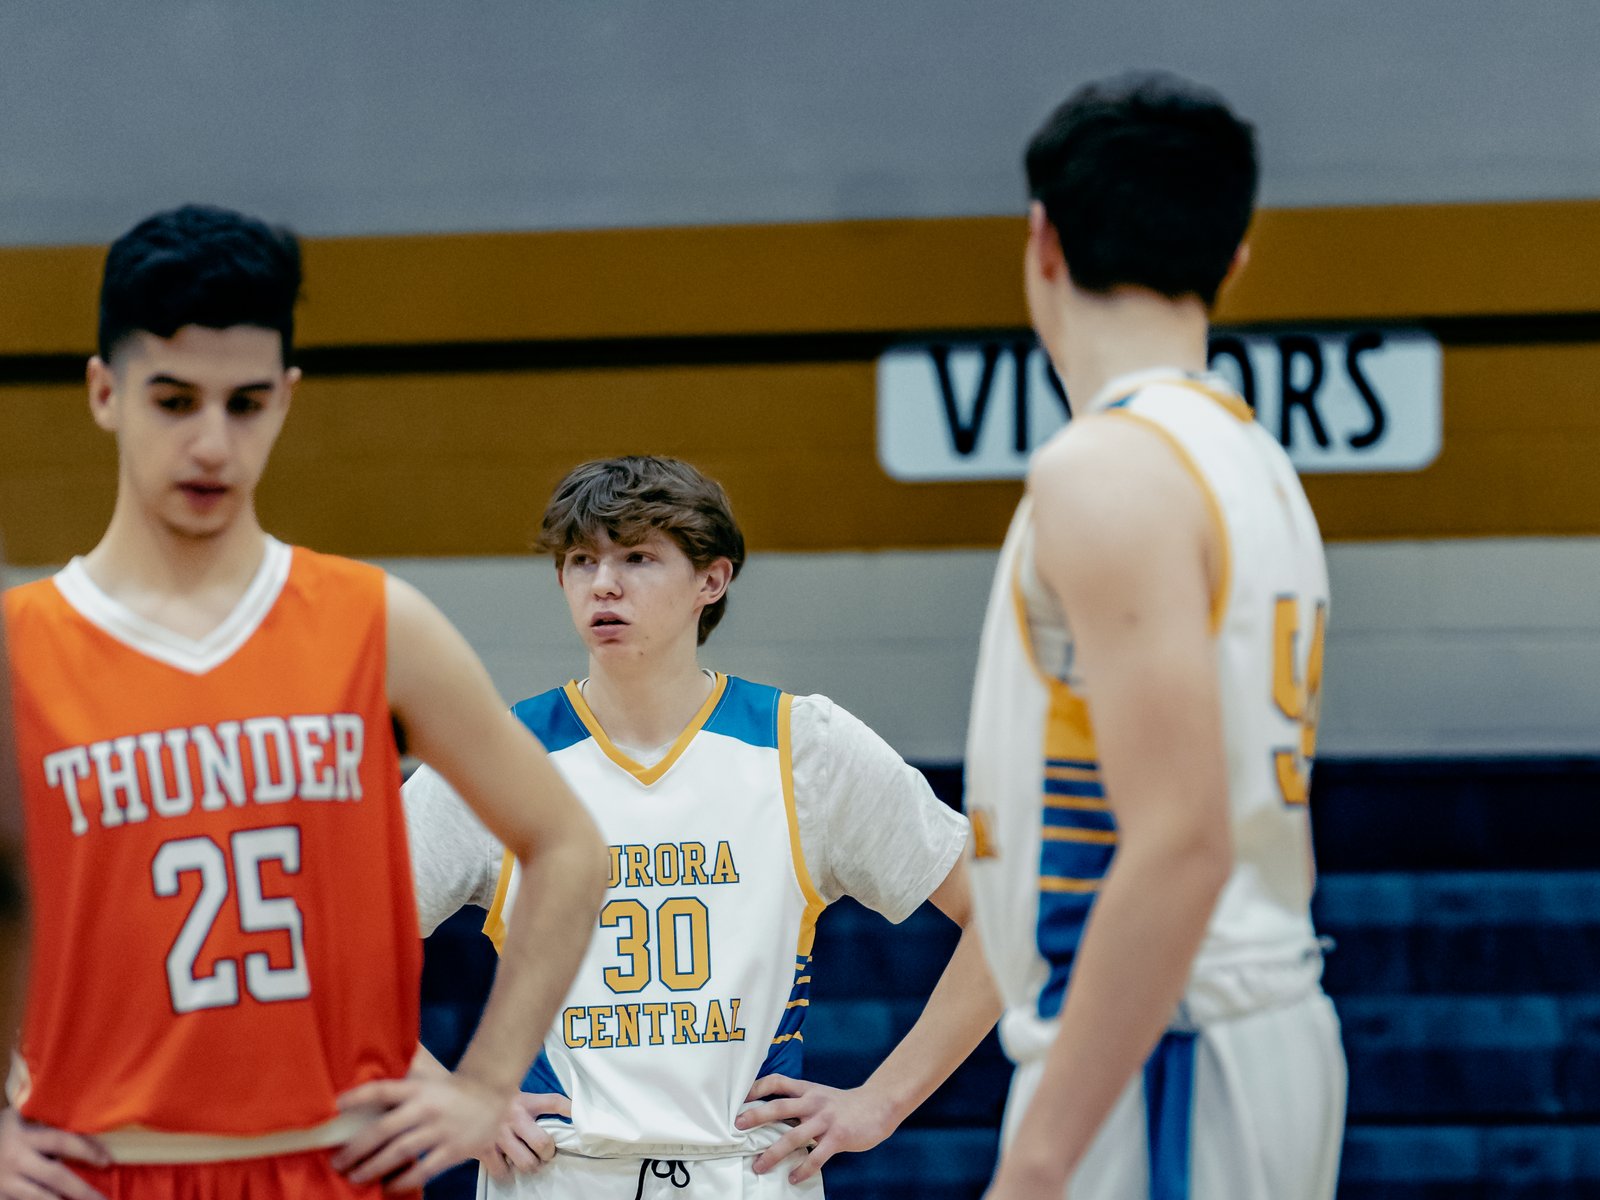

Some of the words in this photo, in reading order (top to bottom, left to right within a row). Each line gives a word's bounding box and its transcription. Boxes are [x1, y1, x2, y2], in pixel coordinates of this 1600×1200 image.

[930, 335, 1385, 455] VIORS
[43, 713, 365, 836] THUNDER
[606, 840, 740, 888] URORA
[151, 824, 311, 1015] 25
[599, 896, 711, 994] 30
[562, 998, 746, 1049] CENTRAL
